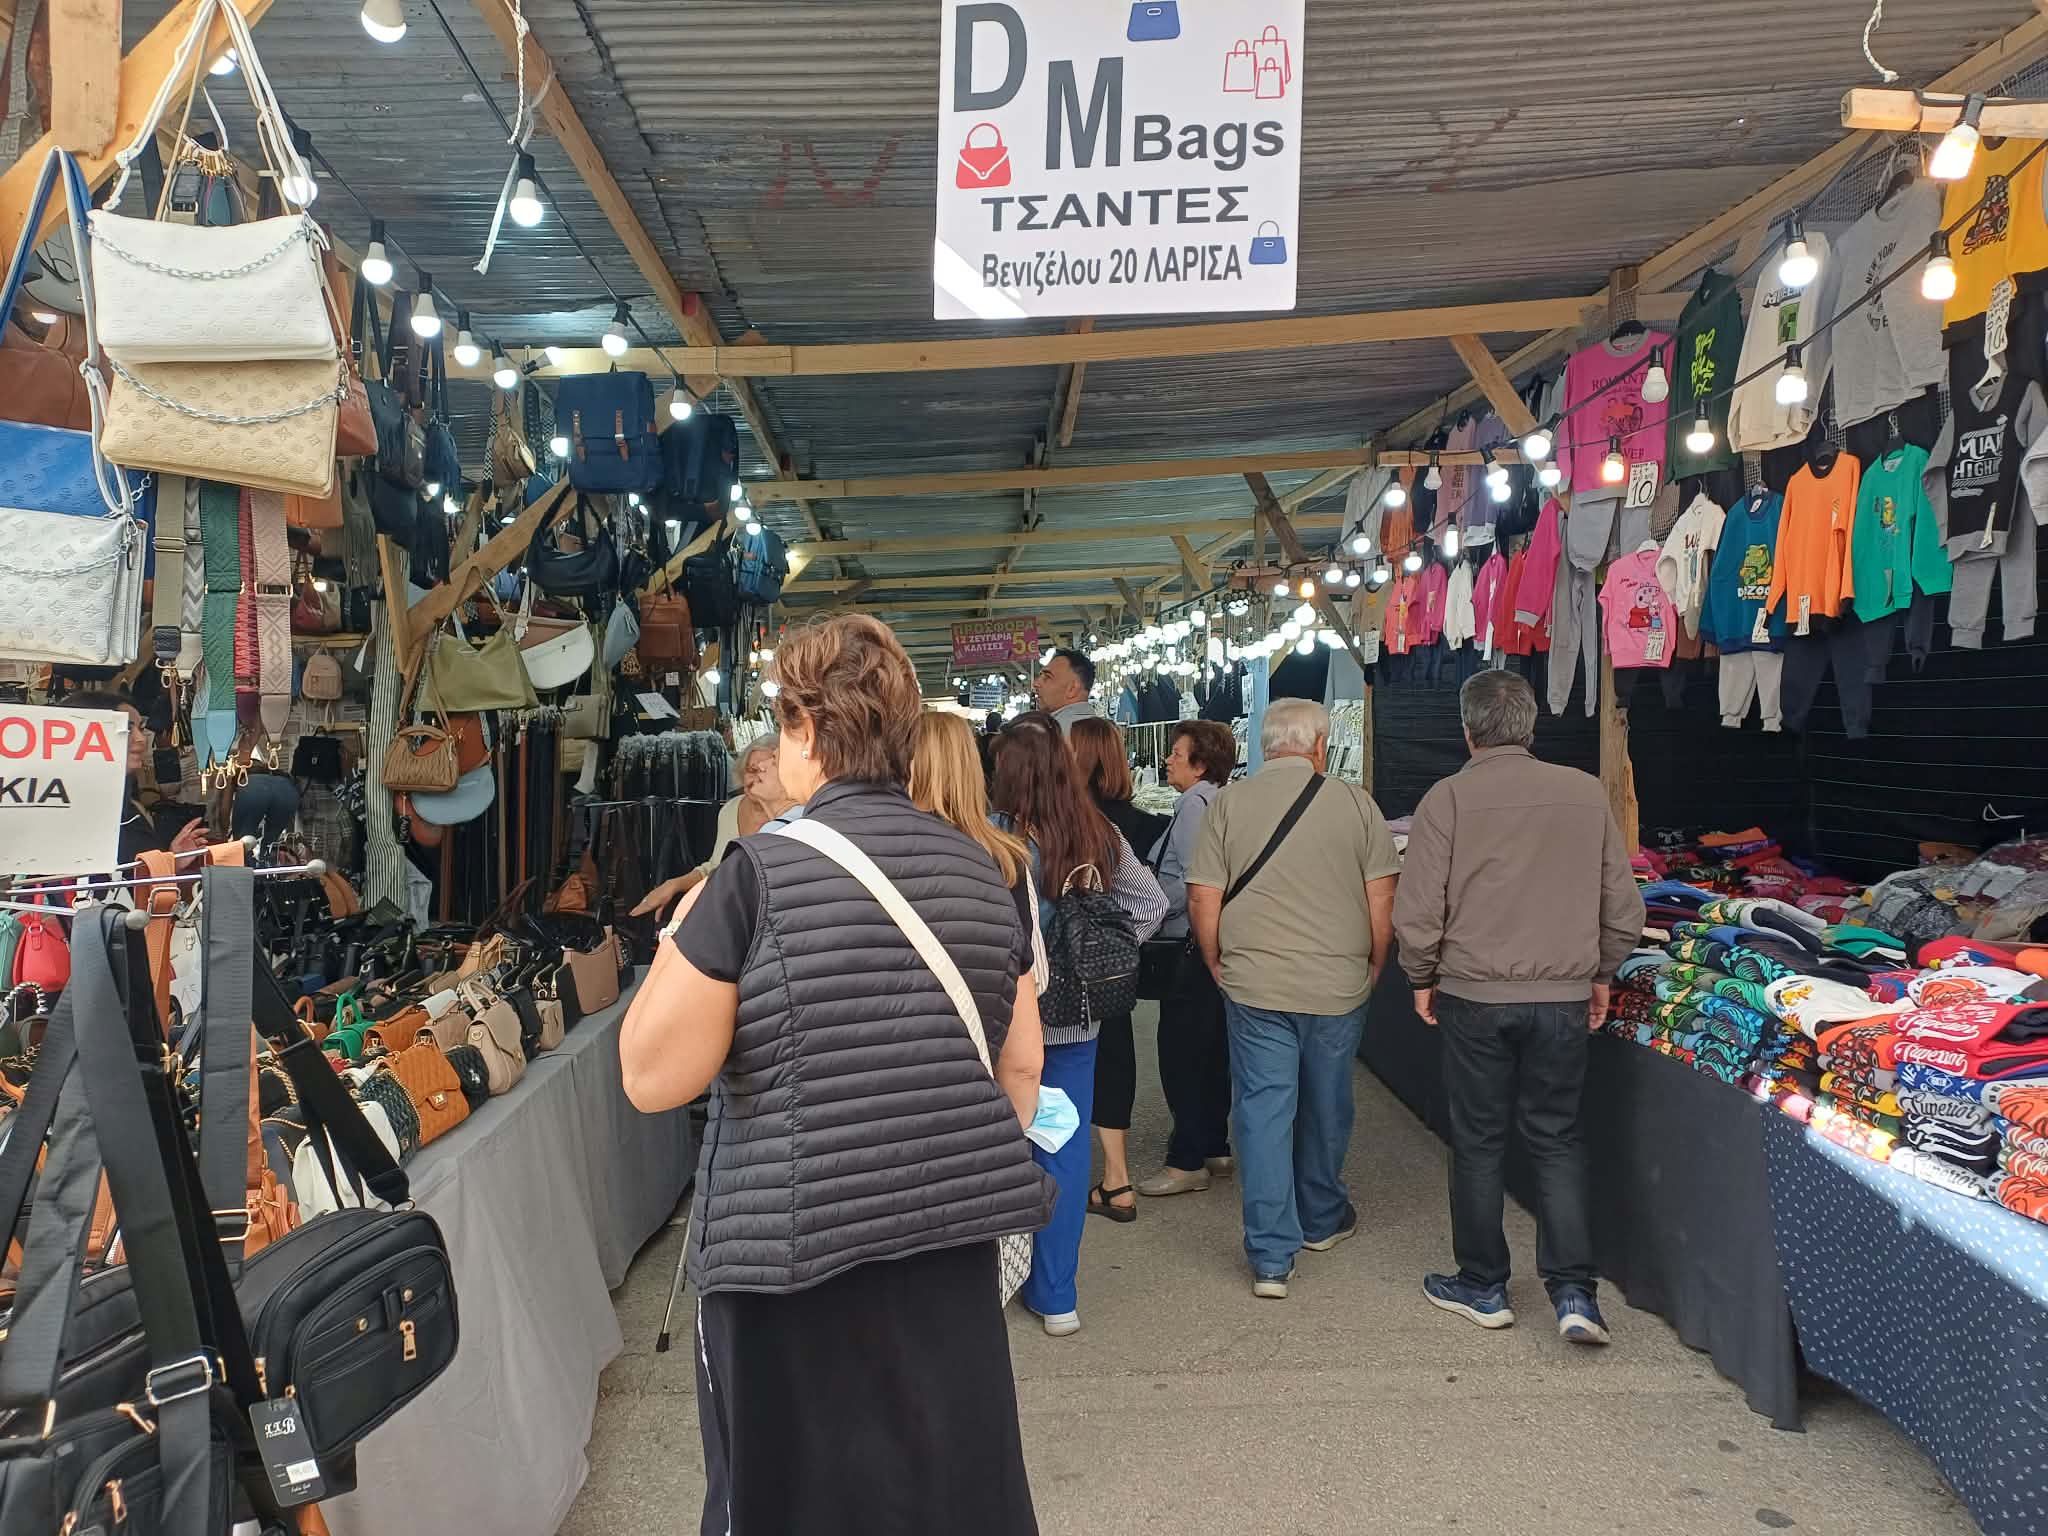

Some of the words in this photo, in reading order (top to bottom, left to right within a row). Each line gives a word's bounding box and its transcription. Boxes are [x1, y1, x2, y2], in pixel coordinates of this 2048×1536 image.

[954, 2, 1028, 113] D
[1045, 56, 1124, 170] M
[1133, 114, 1285, 172] Bags
[981, 186, 1249, 232] ΤΣΑΝΤΕΣ
[982, 253, 1102, 296] Βενιζέλου
[1109, 248, 1138, 284] 20
[1144, 245, 1243, 282] ΛΑΡΙΣΑ
[1631, 480, 1653, 506] 10
